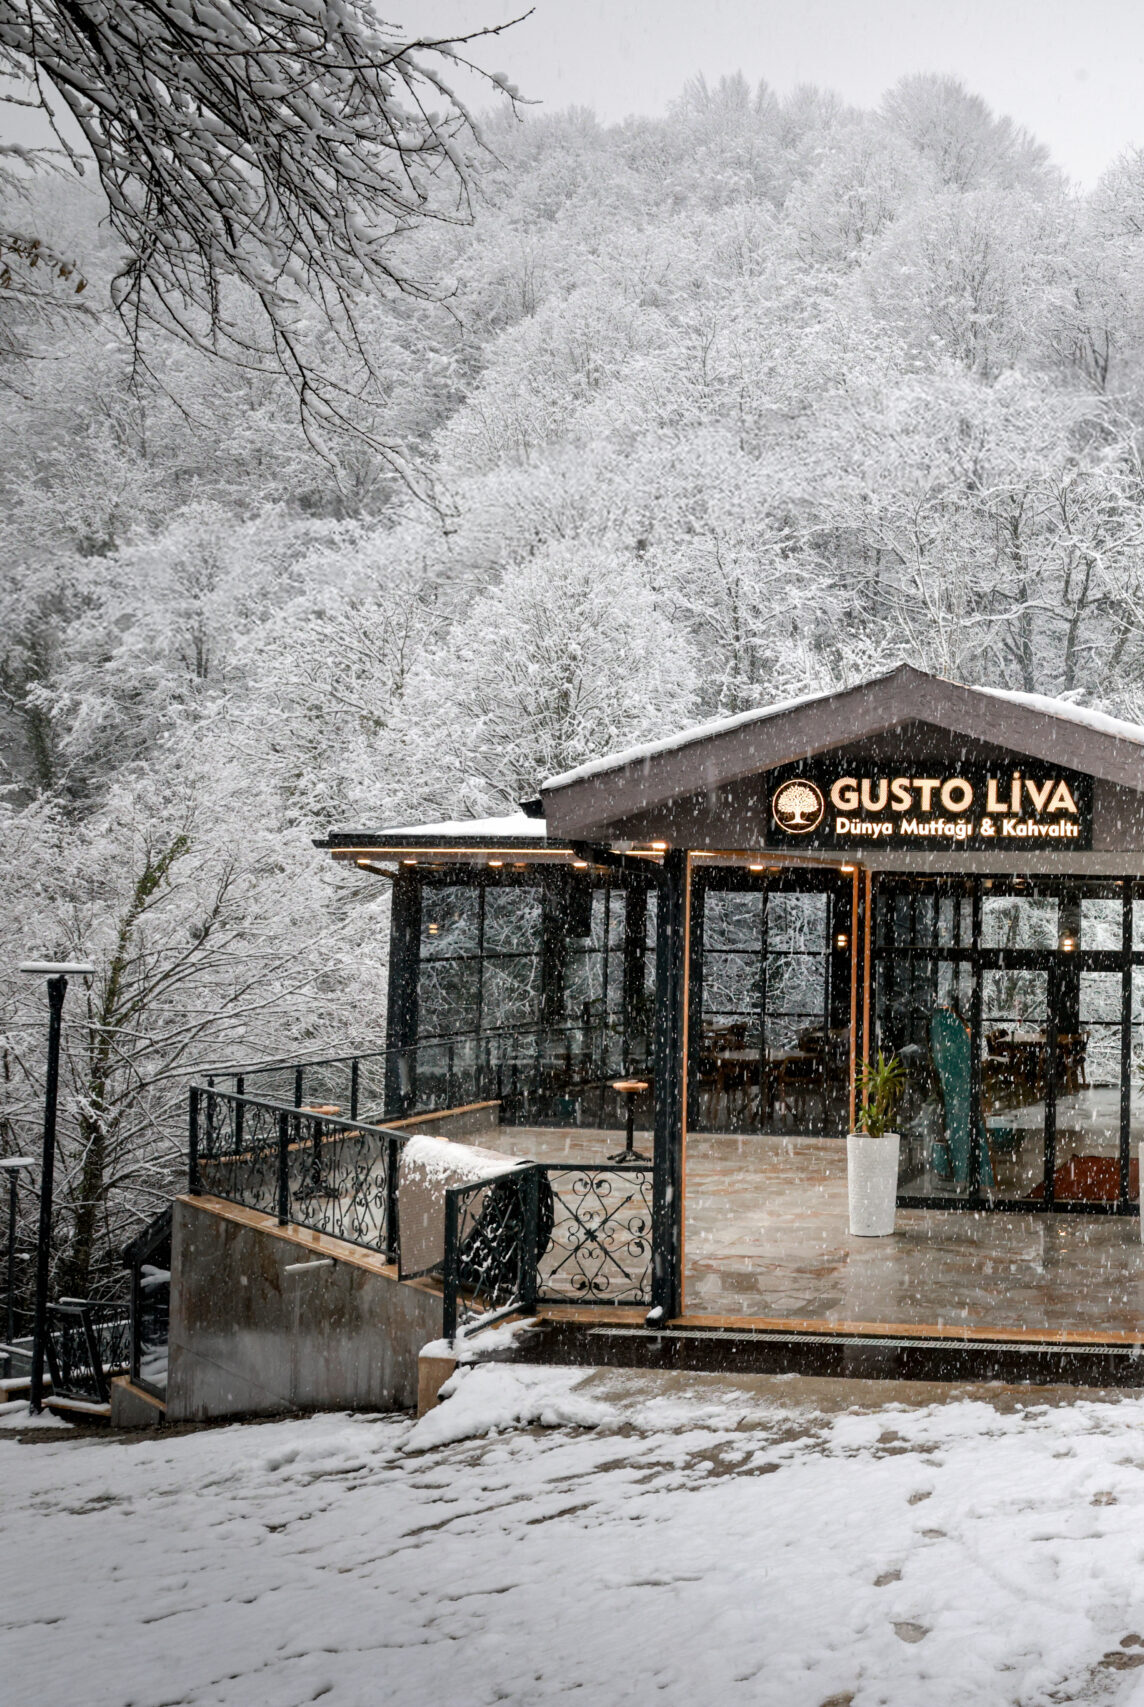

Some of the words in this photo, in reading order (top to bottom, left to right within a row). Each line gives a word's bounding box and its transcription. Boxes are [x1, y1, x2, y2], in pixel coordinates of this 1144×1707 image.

[831, 777, 973, 812] GUSTO
[986, 771, 1078, 813] LİVA
[836, 817, 893, 835] Dünya
[901, 817, 973, 838] Mutfağı
[981, 819, 995, 836] &
[1003, 819, 1078, 837] Kahvaltı
